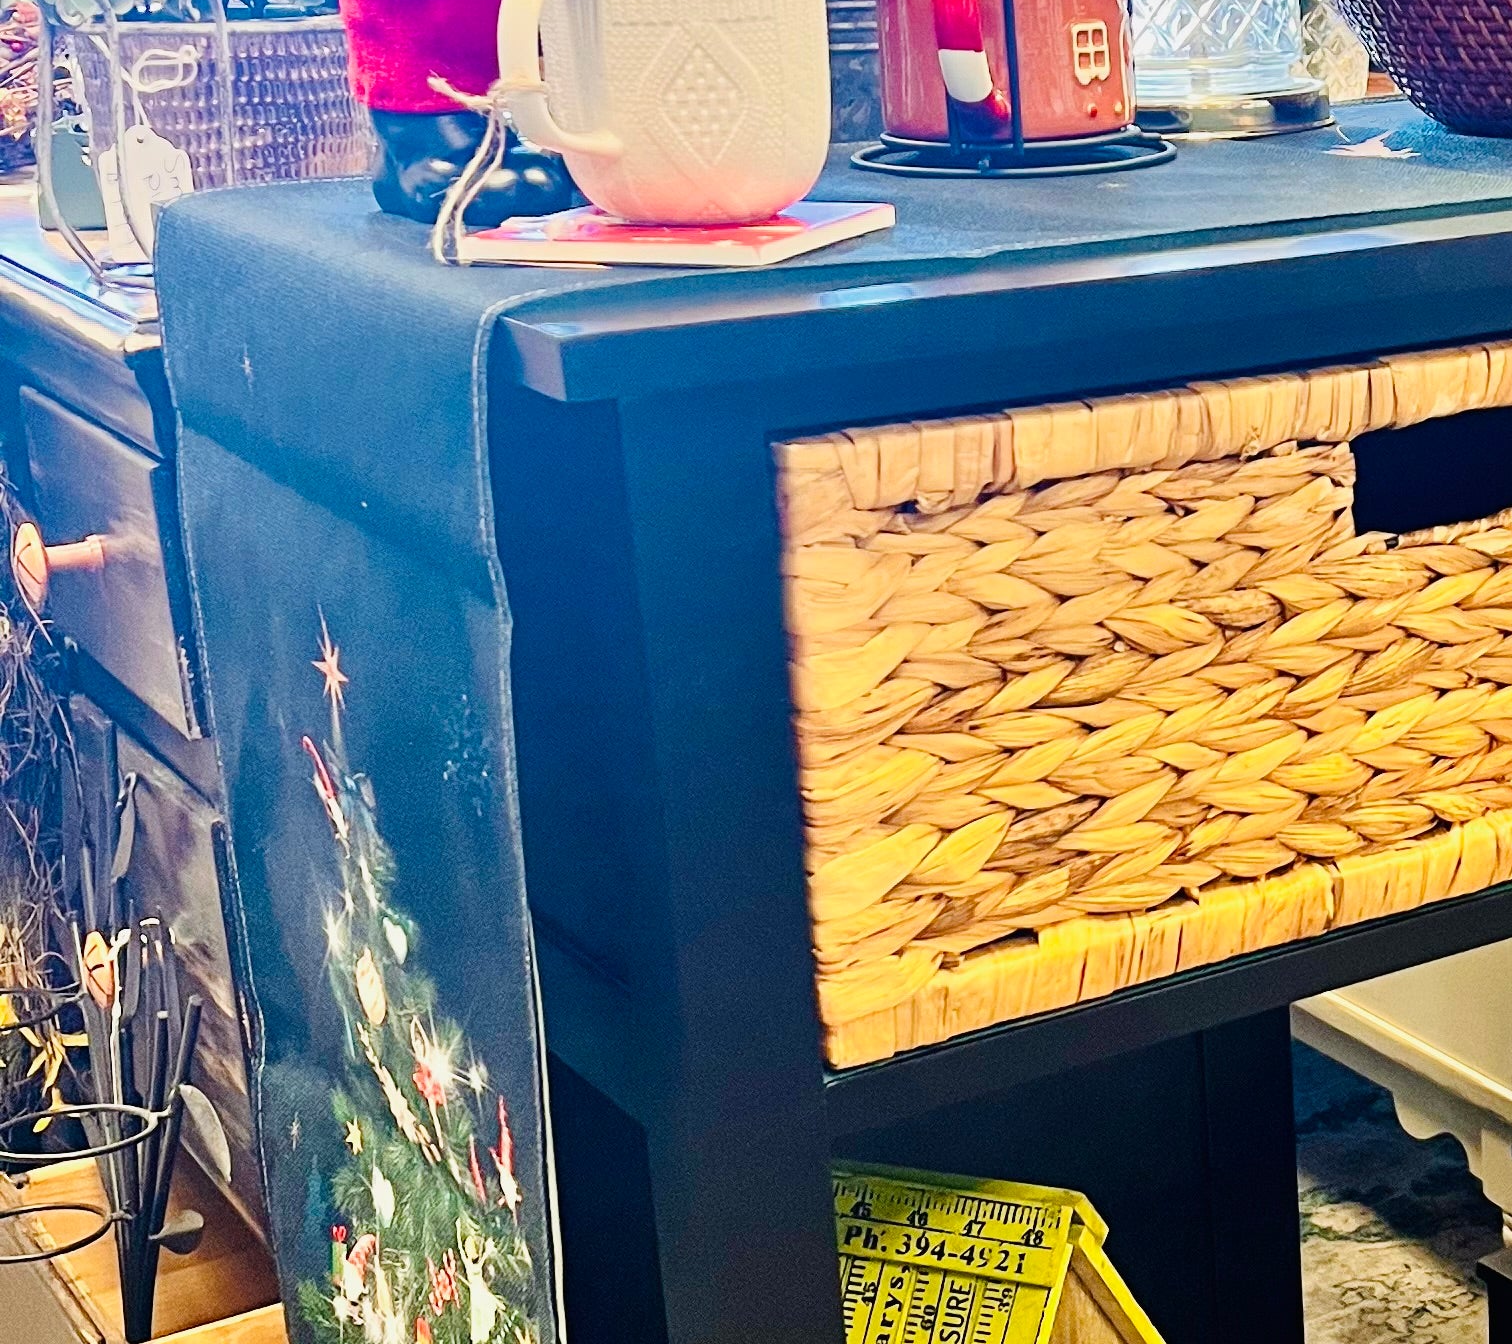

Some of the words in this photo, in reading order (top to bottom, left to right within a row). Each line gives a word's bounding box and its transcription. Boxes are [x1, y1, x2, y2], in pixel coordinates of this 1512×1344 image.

[906, 1210, 929, 1227] 46
[963, 1220, 987, 1237] 47
[1020, 1229, 1045, 1246] 48
[894, 1232, 1027, 1275] 394-4921
[997, 1287, 1014, 1313] 39
[920, 1304, 936, 1331] 60
